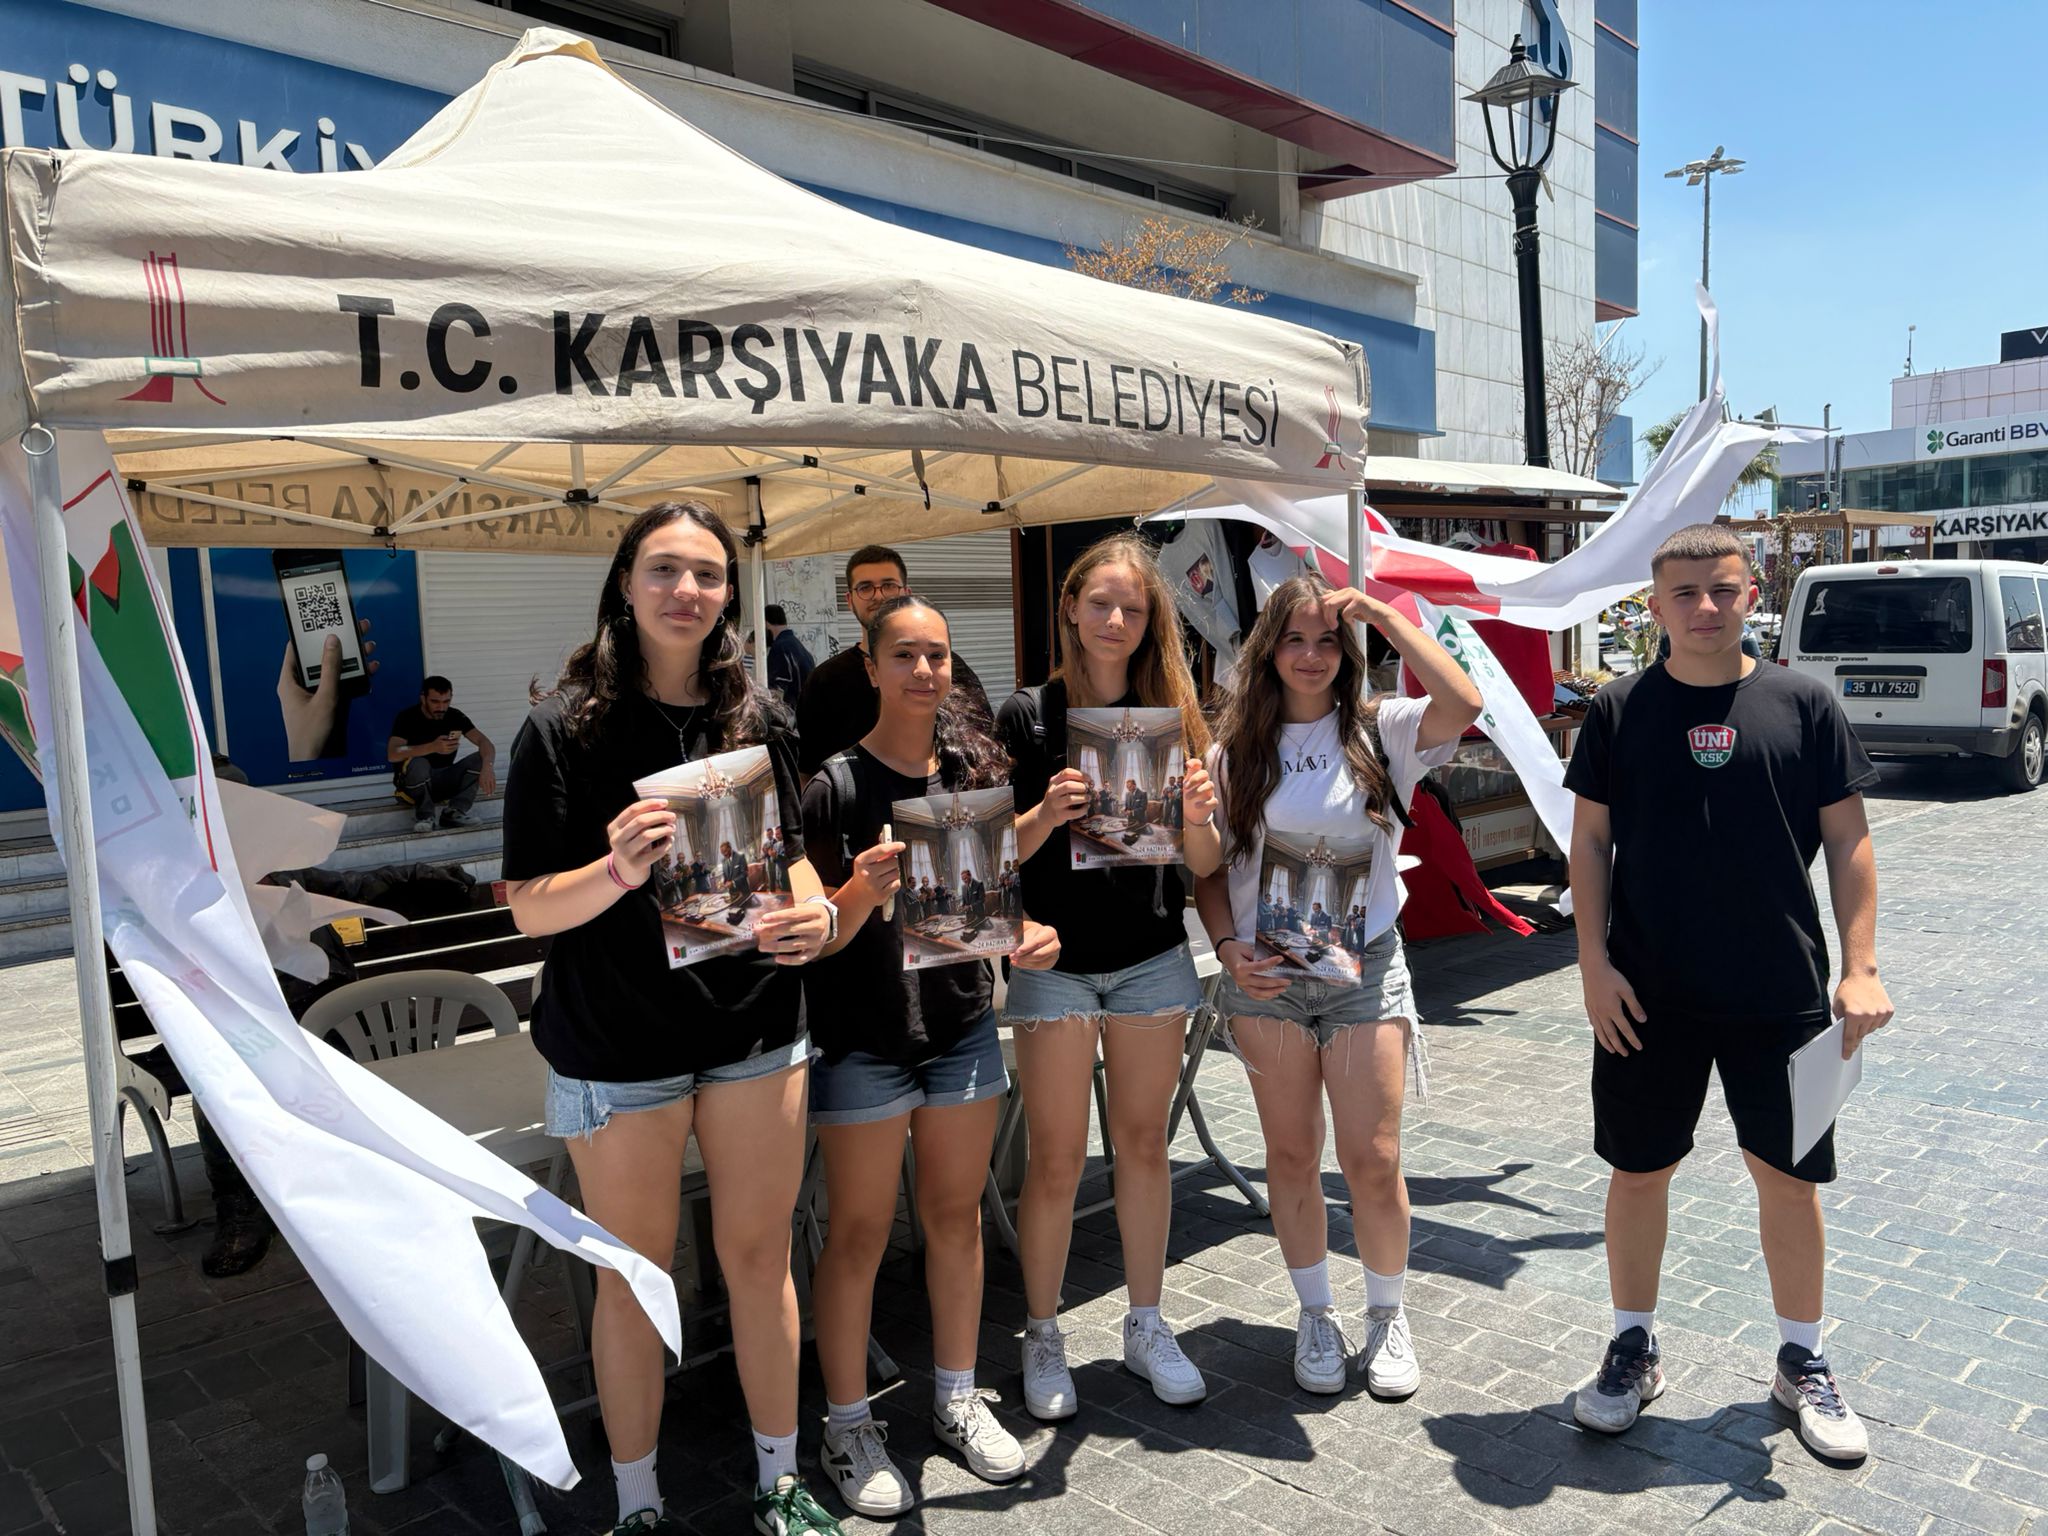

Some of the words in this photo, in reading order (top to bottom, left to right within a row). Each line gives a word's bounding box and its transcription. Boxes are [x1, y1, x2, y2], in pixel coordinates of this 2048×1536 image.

[337, 294, 518, 394] T.C.
[553, 310, 998, 414] KARŞIYAKA
[1012, 349, 1279, 448] BELEDİYESİ
[1946, 427, 2005, 447] Garanti
[1852, 682, 1866, 693] 35
[1870, 682, 1885, 694] AY
[1887, 682, 1917, 694] 7520
[1700, 752, 1724, 763] KSK
